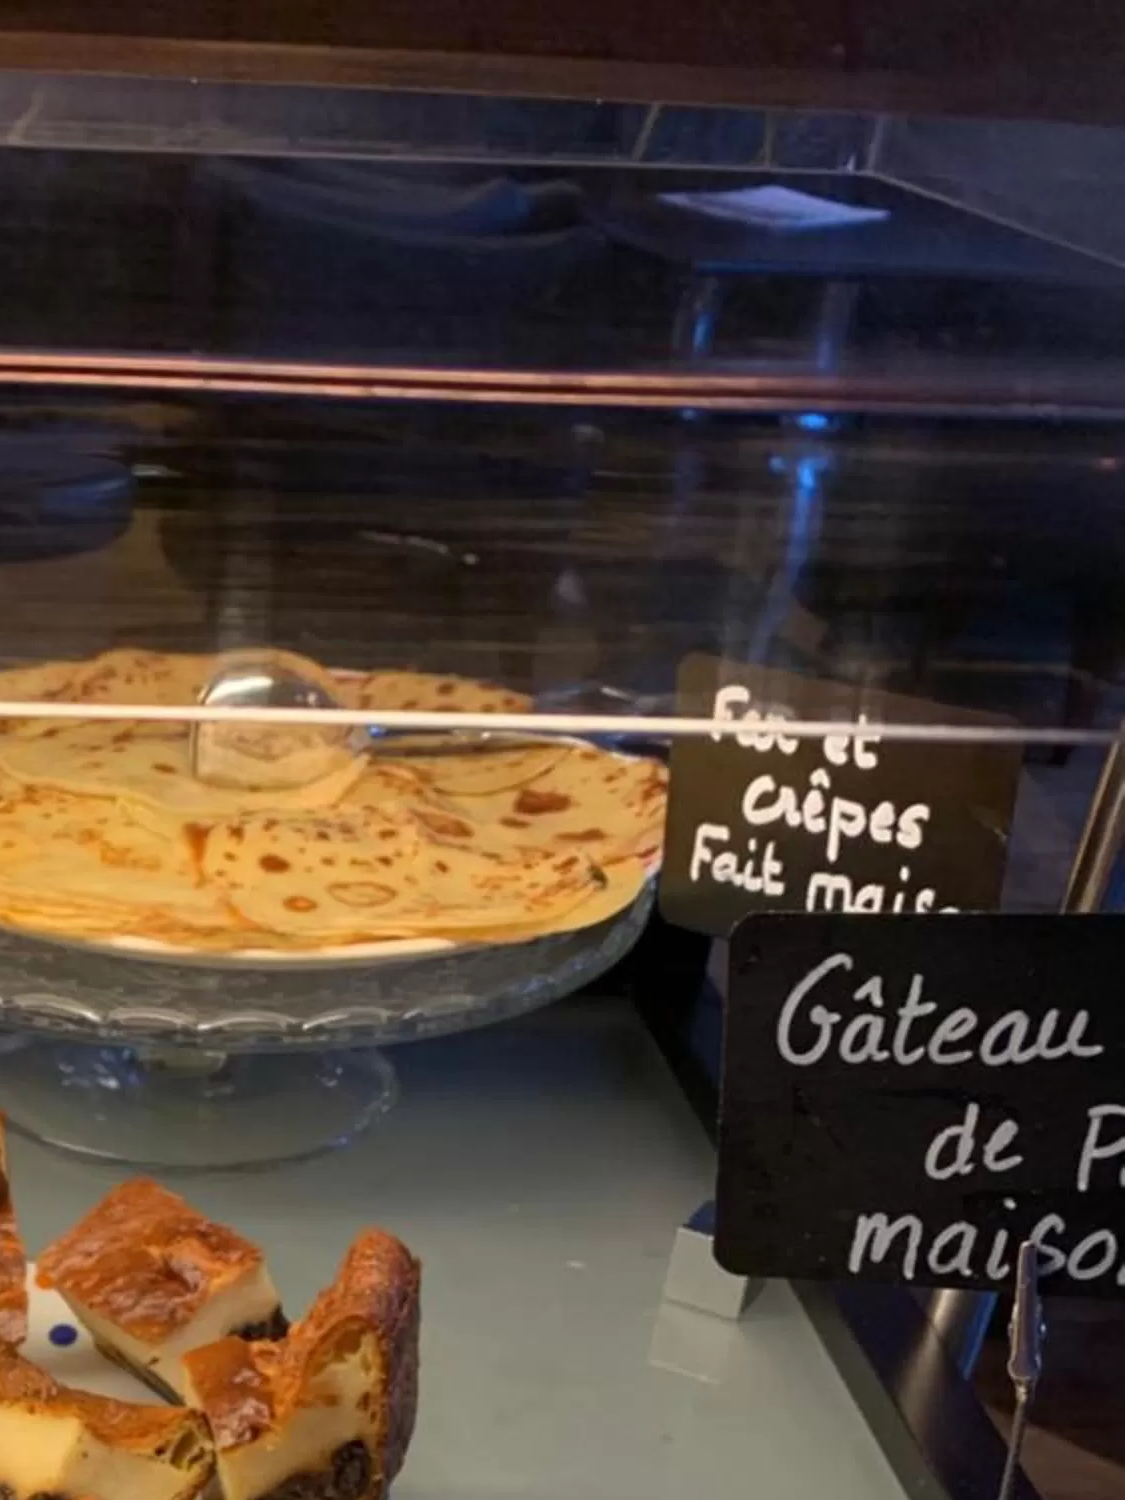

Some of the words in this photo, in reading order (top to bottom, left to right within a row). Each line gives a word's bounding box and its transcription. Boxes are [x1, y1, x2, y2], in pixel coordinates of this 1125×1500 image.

[742, 768, 930, 862] Crêpes
[690, 823, 785, 896] Fait
[806, 865, 961, 914] mais
[777, 953, 1104, 1066] Gâteau
[924, 1102, 1023, 1180] de
[1077, 1104, 1125, 1193] P
[848, 1198, 1125, 1287] maiso
